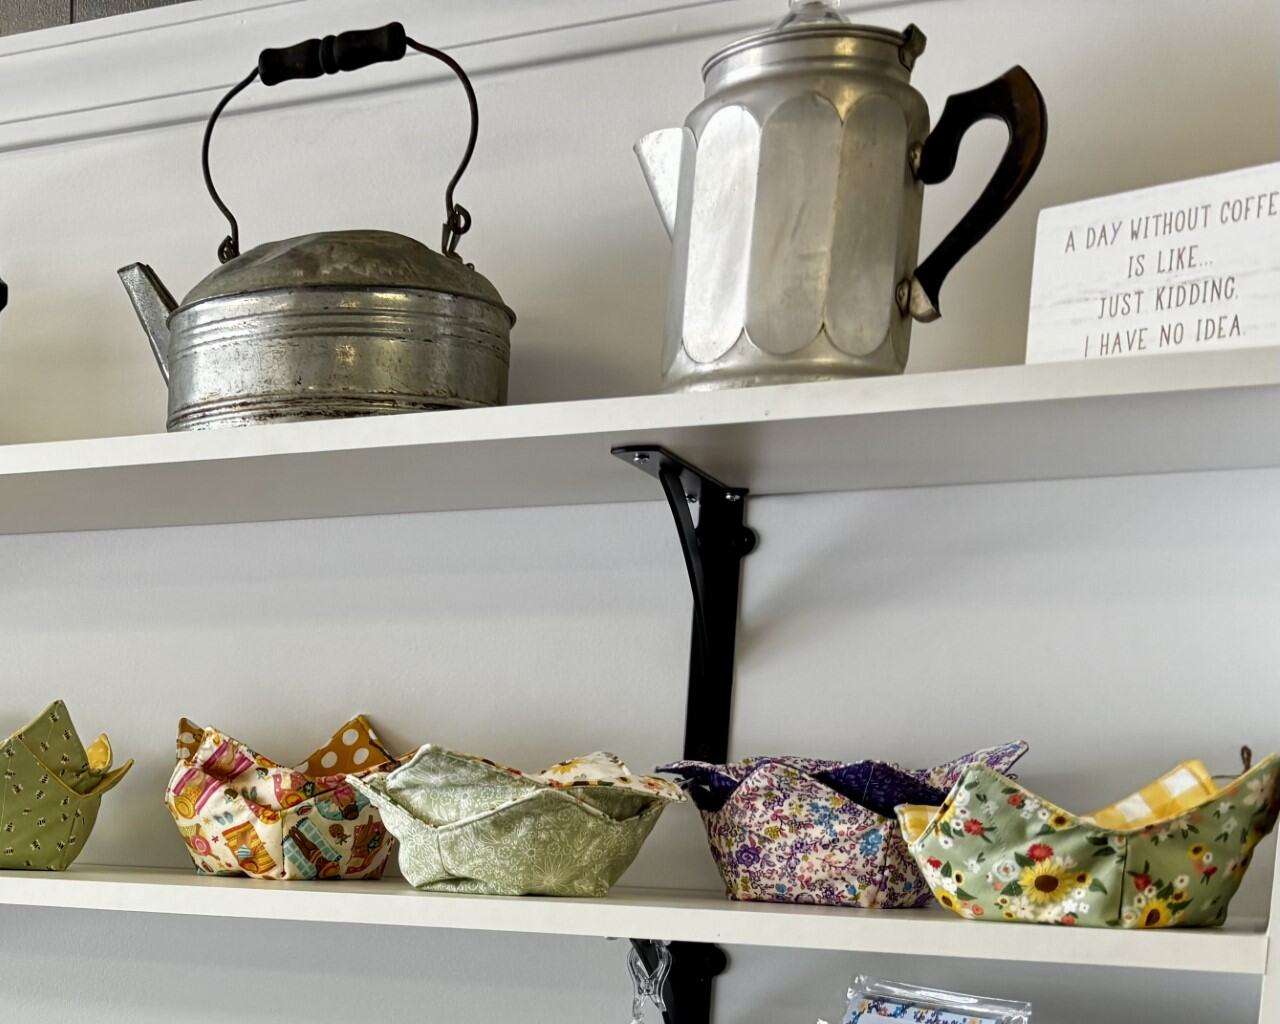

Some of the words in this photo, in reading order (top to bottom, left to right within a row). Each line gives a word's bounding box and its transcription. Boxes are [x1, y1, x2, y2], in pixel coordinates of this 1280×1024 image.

[1064, 230, 1076, 254] A
[1086, 220, 1123, 250] DAY
[1130, 203, 1212, 242] WITHOUT
[1220, 190, 1280, 224] COFFE
[1128, 254, 1145, 279] IS
[1098, 291, 1144, 320] JUST
[1084, 335, 1090, 358] I
[1100, 327, 1148, 357] HAVE
[1159, 322, 1184, 348] NO
